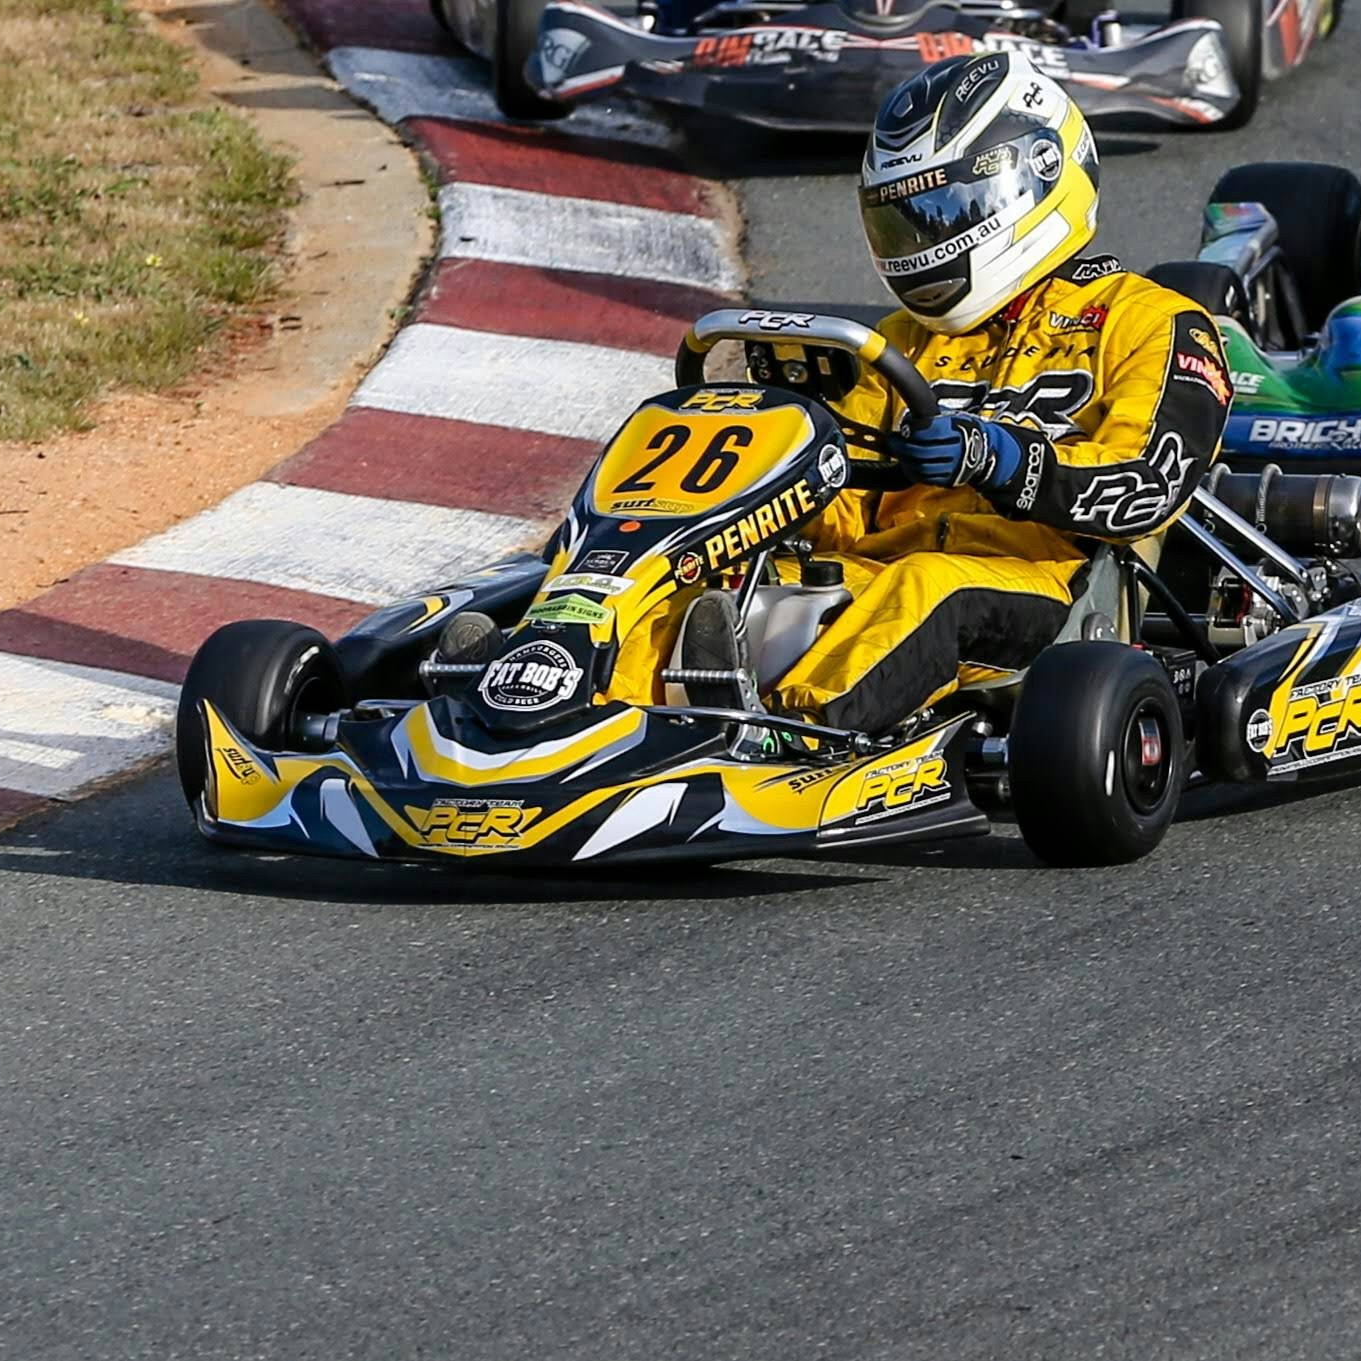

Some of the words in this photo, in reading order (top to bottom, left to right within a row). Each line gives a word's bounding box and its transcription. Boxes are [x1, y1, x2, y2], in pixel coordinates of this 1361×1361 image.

[956, 60, 1000, 102] REEVU
[880, 168, 947, 202] PENRITE
[612, 424, 753, 494] 26
[1016, 442, 1042, 511] sparco
[704, 478, 816, 571] PENRITE
[482, 662, 525, 690] FAT
[518, 662, 582, 697] BOB'S
[1290, 678, 1342, 699] FACTORY
[856, 758, 951, 810] PCR
[419, 806, 524, 844] PCR
